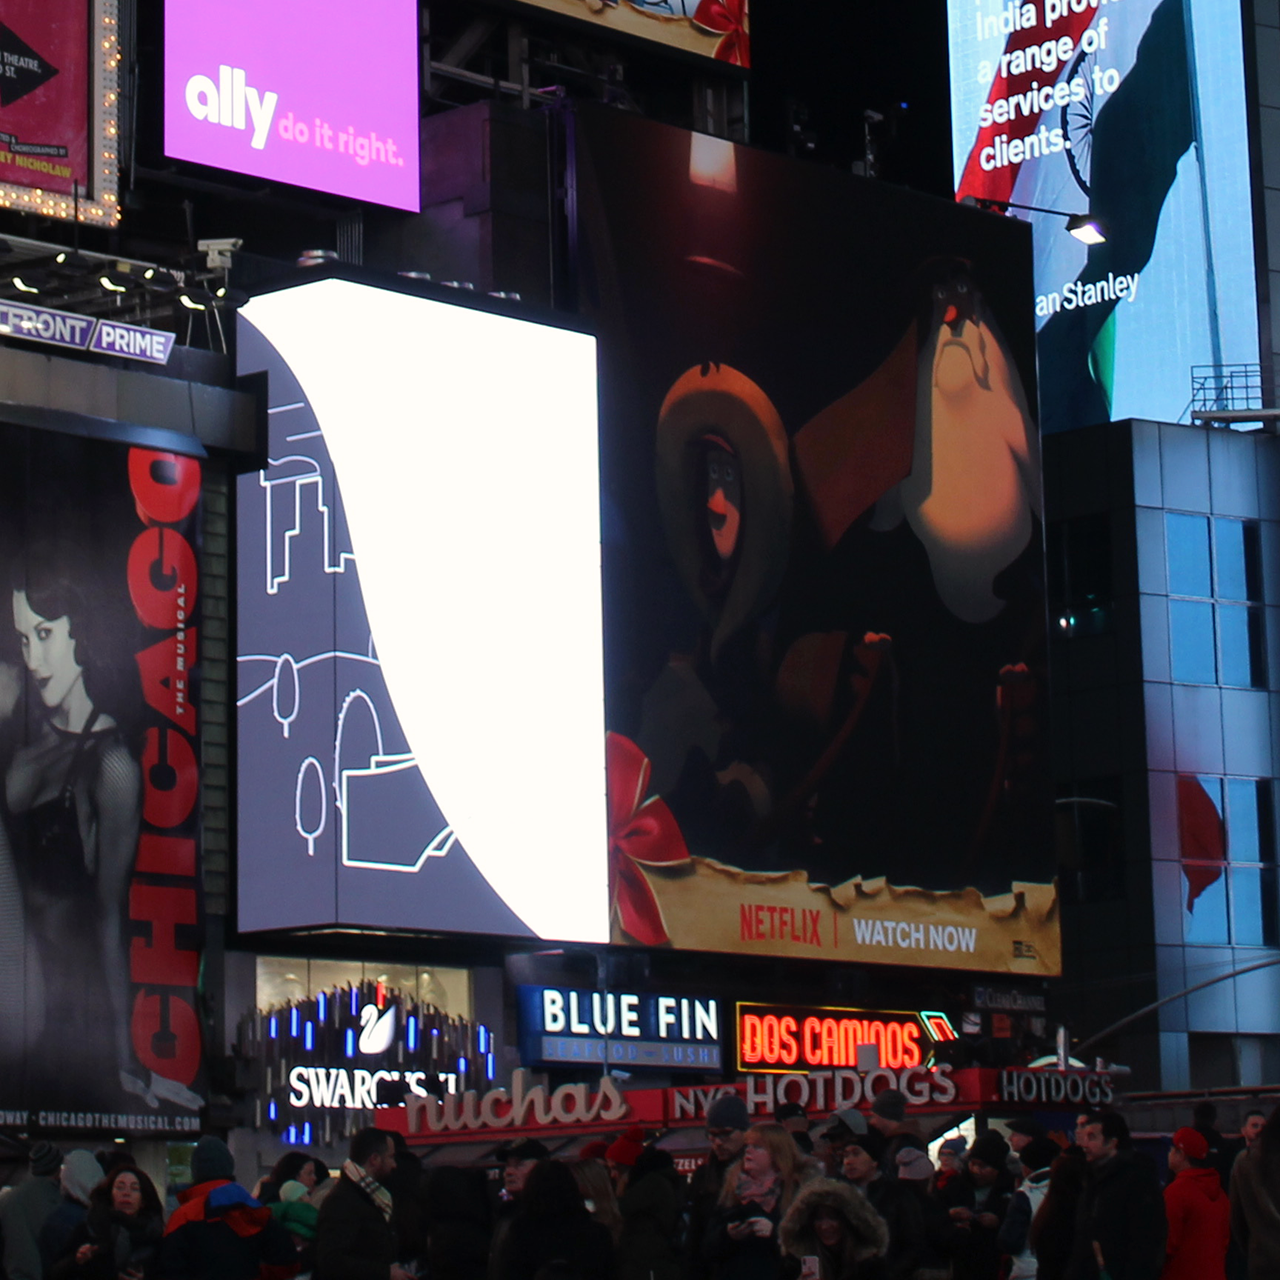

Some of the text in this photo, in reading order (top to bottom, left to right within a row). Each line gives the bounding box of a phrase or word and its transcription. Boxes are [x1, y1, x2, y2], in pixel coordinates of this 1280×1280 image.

[976, 2, 1037, 42] India
[977, 17, 1109, 85] a range of
[185, 64, 405, 169] ally do it right.
[977, 62, 1121, 129] services to
[15, 155, 71, 178] NICHOLAW
[979, 124, 1072, 173] clients.
[1062, 268, 1140, 312] Stanley
[100, 326, 166, 360] PRIME
[175, 583, 187, 716] THE MUSICAL
[127, 447, 202, 1086] CHICAGO
[739, 901, 823, 948] NETFLIX
[852, 917, 926, 950] WATCH
[928, 922, 977, 954] NOW
[543, 988, 718, 1041] BLUE FIN
[742, 1014, 798, 1064] DOS
[544, 1041, 719, 1064] SEAFOOD SUSHI
[404, 1067, 629, 1136] nuchas
[746, 1063, 958, 1114] HOTDOGS
[1001, 1071, 1114, 1106] HOTDOGS
[39, 1111, 200, 1131] CHICAGOTHEMUSICAL.COM
